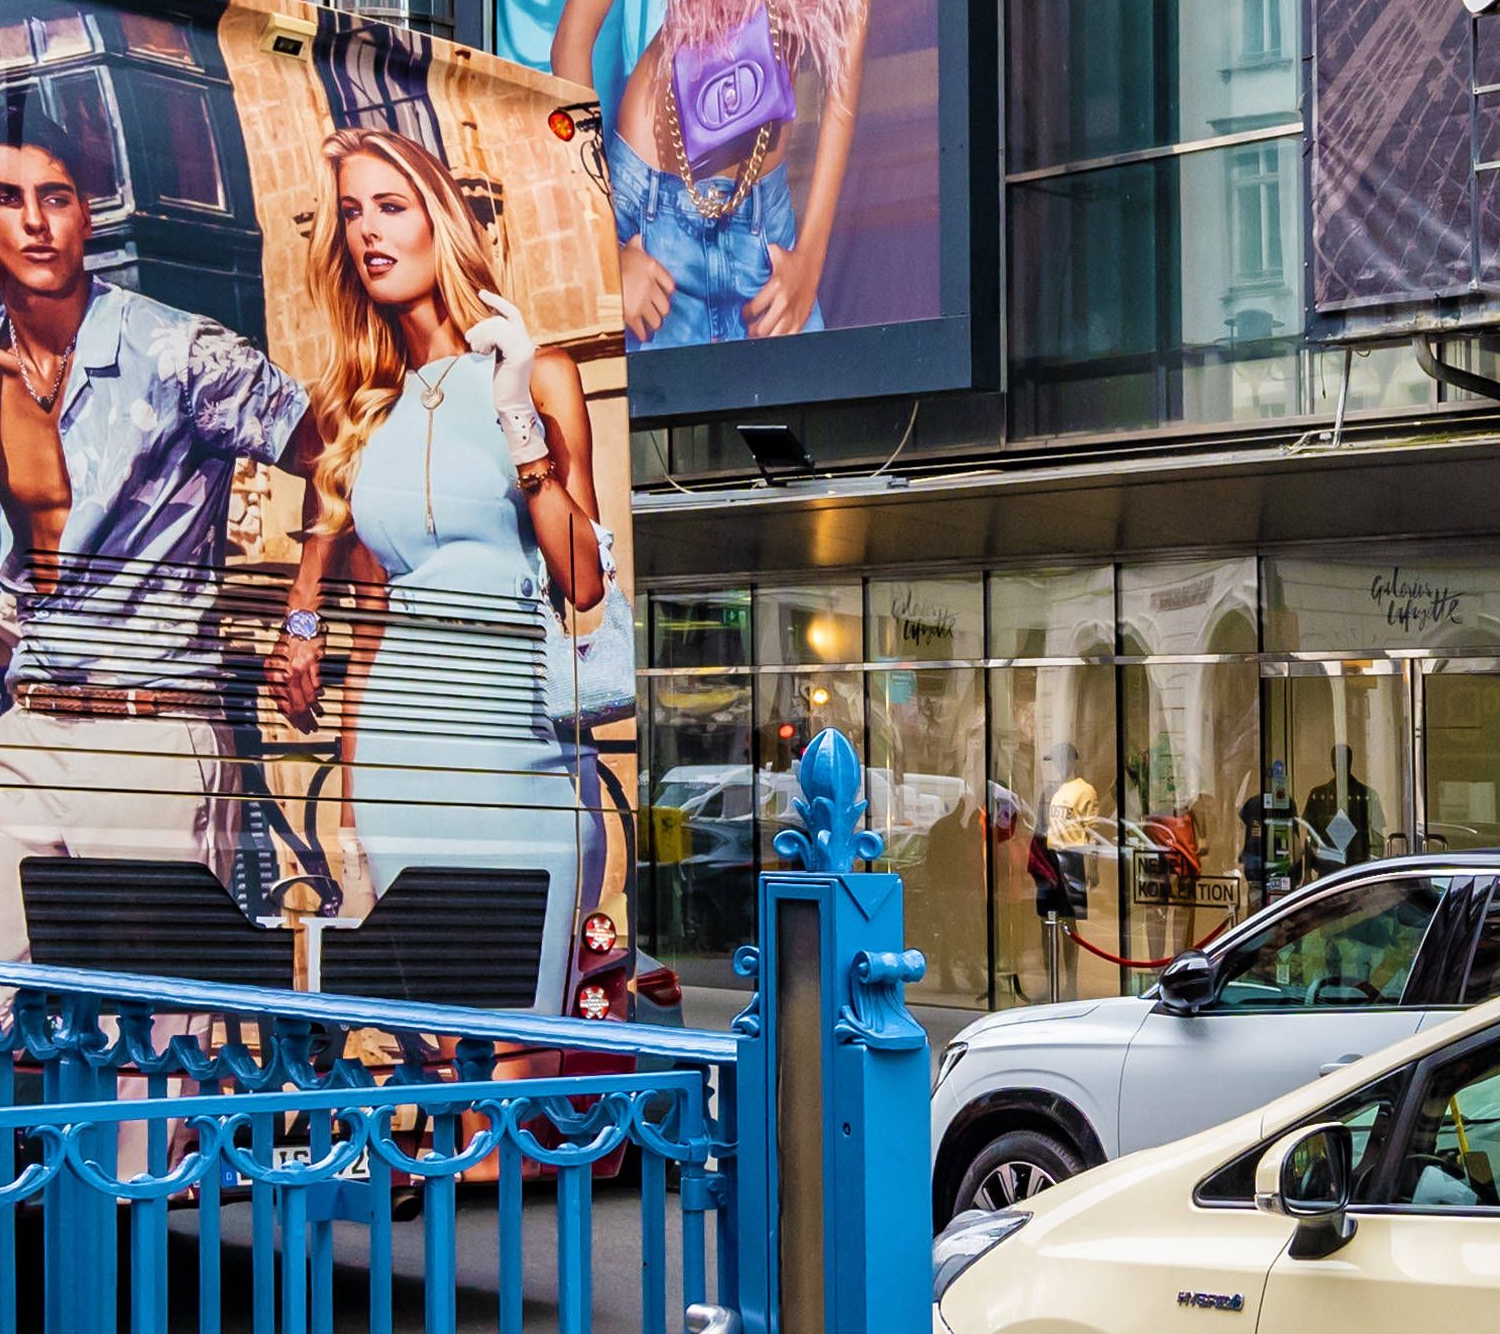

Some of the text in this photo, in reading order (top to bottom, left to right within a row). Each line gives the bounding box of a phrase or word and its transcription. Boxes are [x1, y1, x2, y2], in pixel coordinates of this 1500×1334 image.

[1371, 566, 1433, 607] Galeries
[1387, 587, 1465, 633] Lafayette
[1138, 880, 1234, 902] KOLETION
